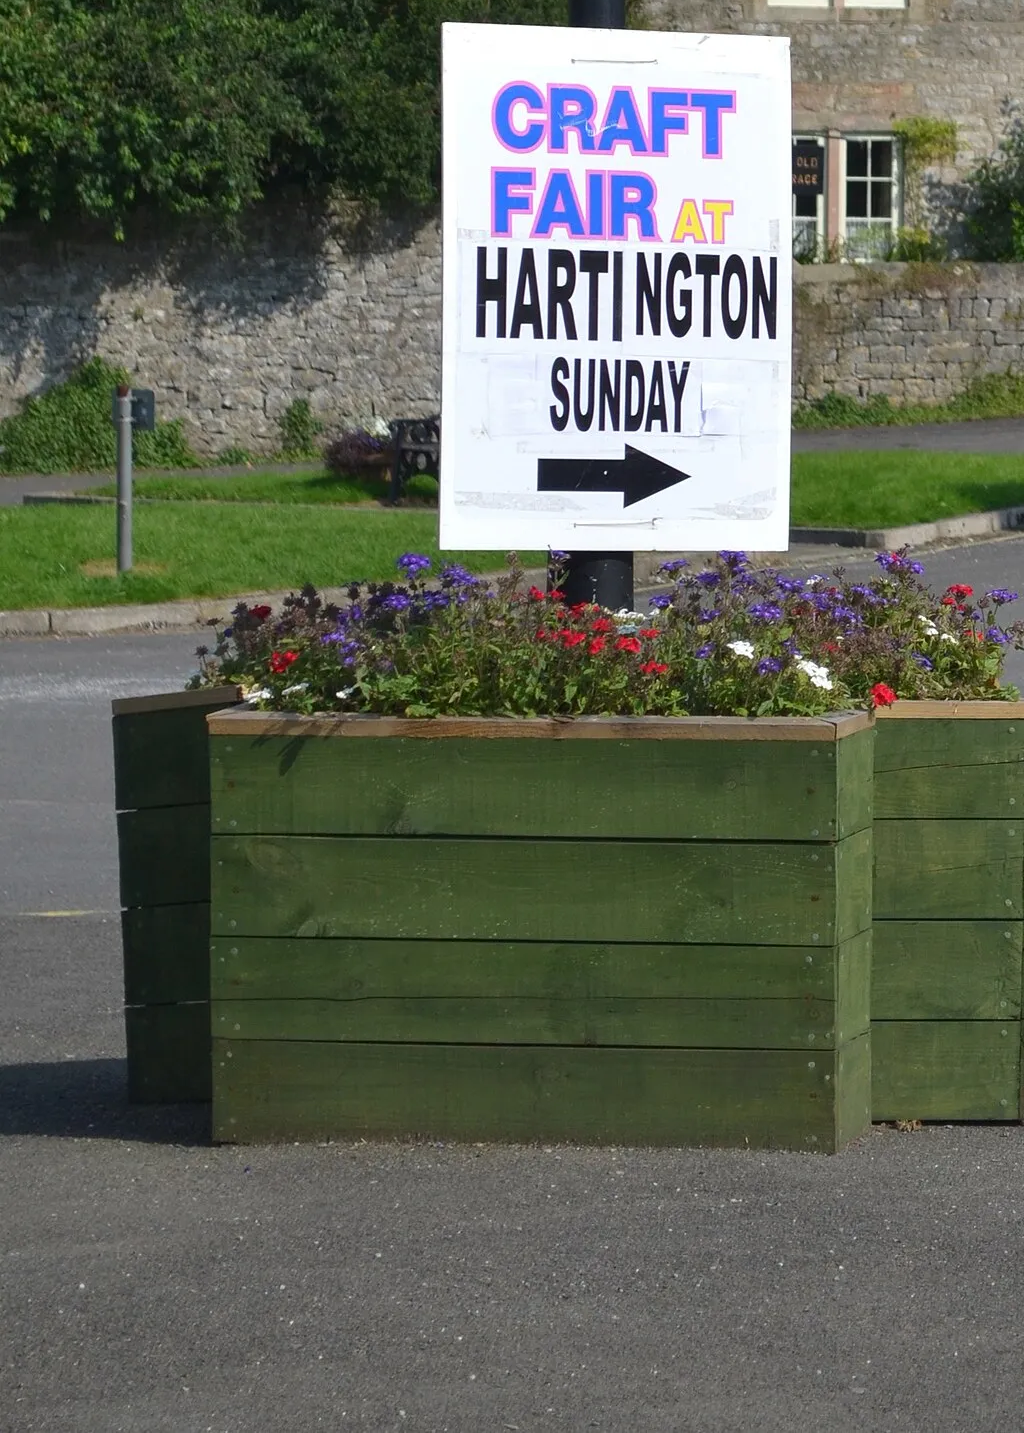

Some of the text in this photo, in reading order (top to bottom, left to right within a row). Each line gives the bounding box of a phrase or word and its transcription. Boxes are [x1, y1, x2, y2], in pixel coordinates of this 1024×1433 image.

[491, 80, 737, 160] CRAFT
[490, 166, 734, 244] FAIR AT
[475, 245, 778, 343] HARTINGTON
[549, 356, 691, 433] SUNDAY
